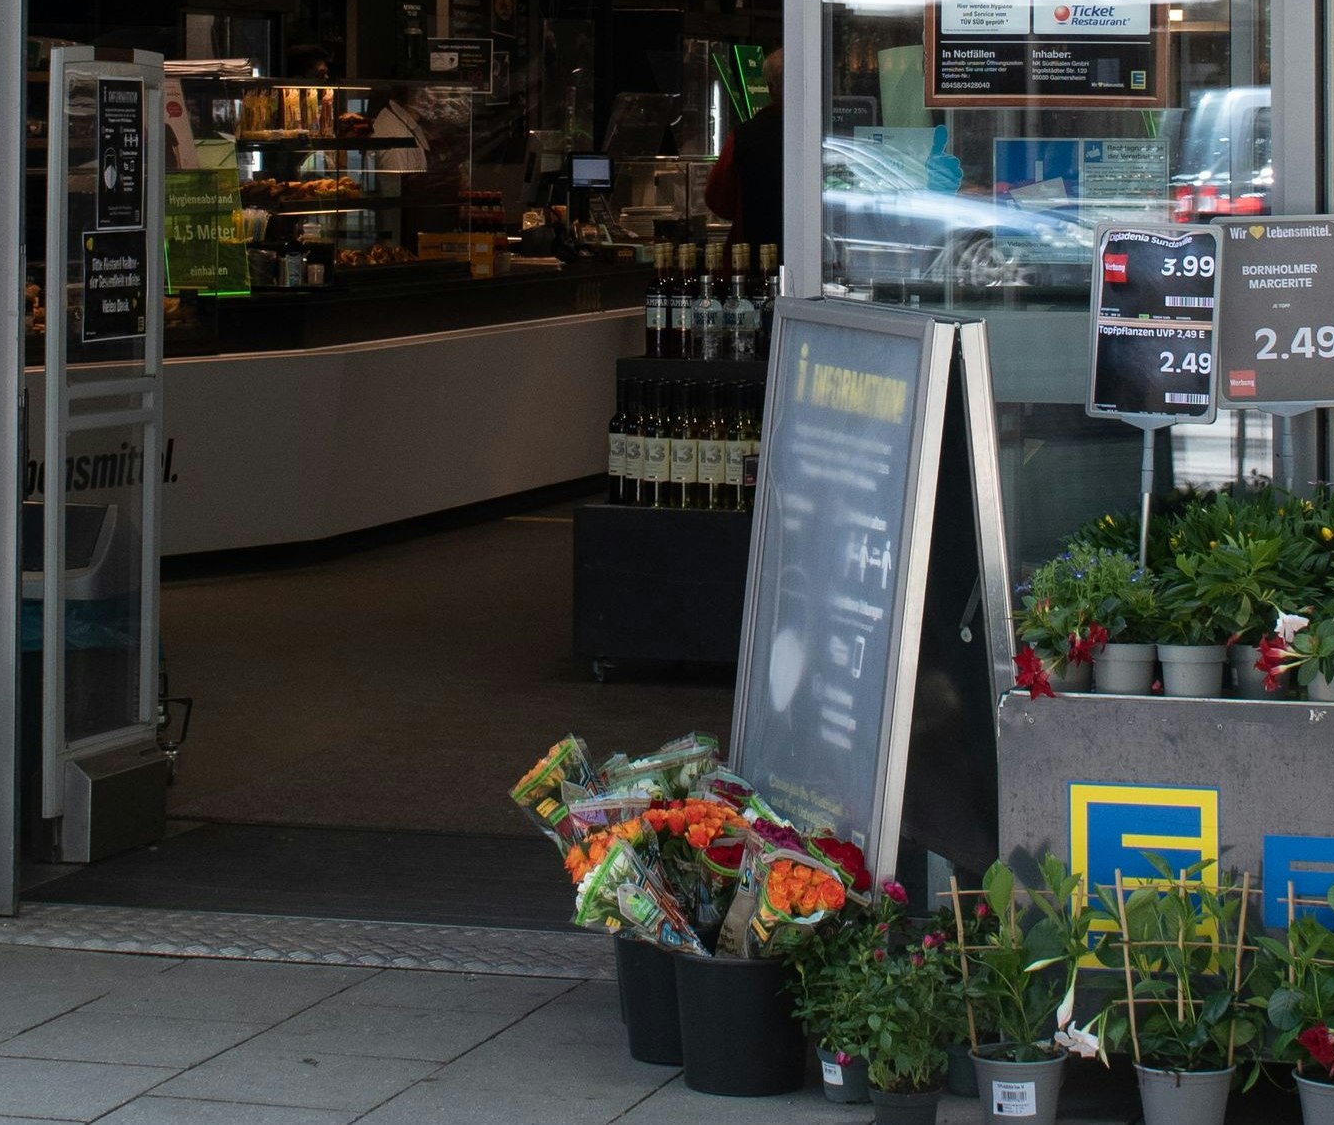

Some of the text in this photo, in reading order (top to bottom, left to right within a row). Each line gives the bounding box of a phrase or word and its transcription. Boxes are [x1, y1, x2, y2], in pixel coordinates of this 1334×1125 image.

[990, 3, 1013, 11] Hygiene
[1072, 5, 1115, 17] Ticket
[942, 49, 995, 59] In Notfällen
[1032, 49, 1072, 59] Inhaber:
[174, 223, 236, 242] 1,5 Meter
[1230, 225, 1332, 240] Wir Lebensmittel.
[190, 266, 228, 276] einhalen
[1104, 262, 1126, 273] Werbung
[1161, 255, 1215, 278] 3.99
[1242, 263, 1318, 275] BORNHOLMER
[1249, 278, 1312, 289] MARGERITE
[1099, 325, 1205, 339] Topfpflanzen UVP 2,49 E
[1159, 351, 1212, 375] 2.49
[1230, 378, 1255, 388] Werbung
